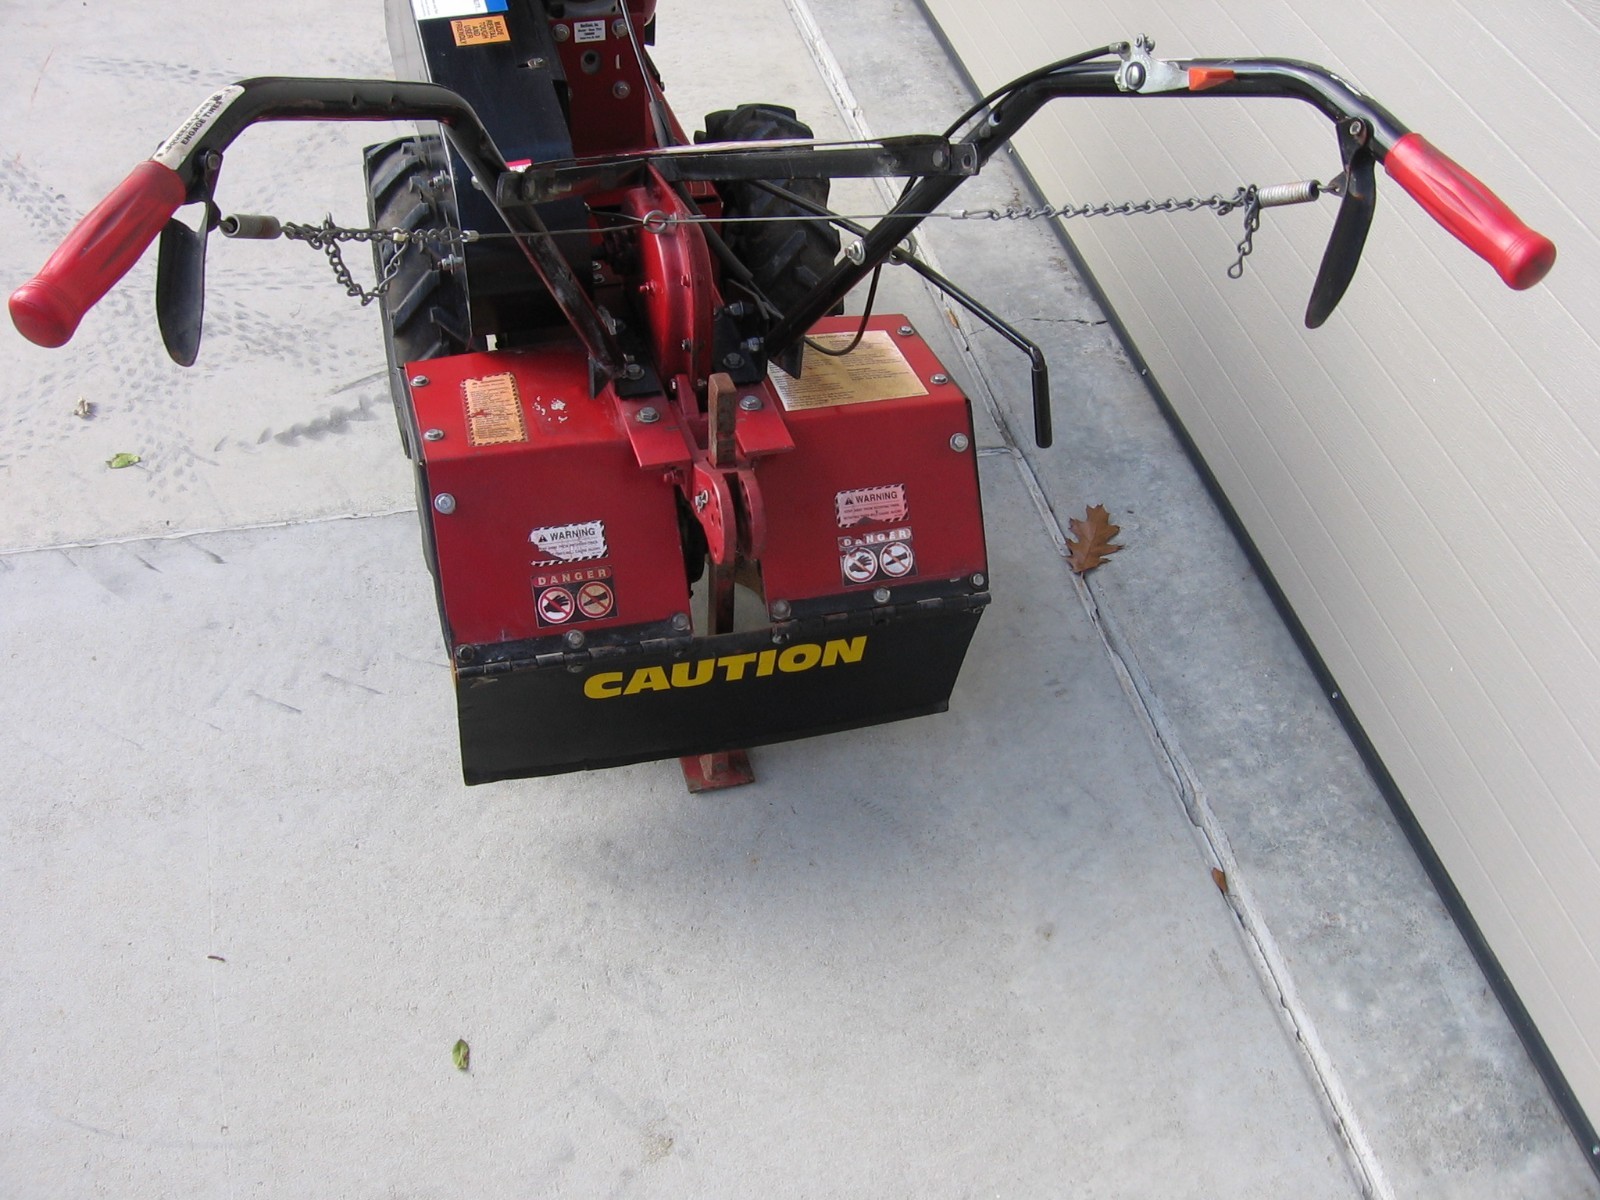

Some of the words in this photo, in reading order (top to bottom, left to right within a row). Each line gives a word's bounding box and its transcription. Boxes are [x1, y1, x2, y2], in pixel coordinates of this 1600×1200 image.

[455, 21, 467, 44] FRIENDLY
[464, 24, 474, 38] USER
[472, 25, 481, 37] AND
[486, 19, 497, 39] RENTAL
[494, 21, 505, 35] MADE
[180, 118, 207, 145] ENGAGE
[202, 101, 223, 117] TINES
[855, 491, 898, 503] WARNING
[550, 527, 596, 541] WARNING
[843, 530, 906, 546] DANGER
[537, 569, 606, 586] DANGER
[583, 635, 868, 700] CAUTION
